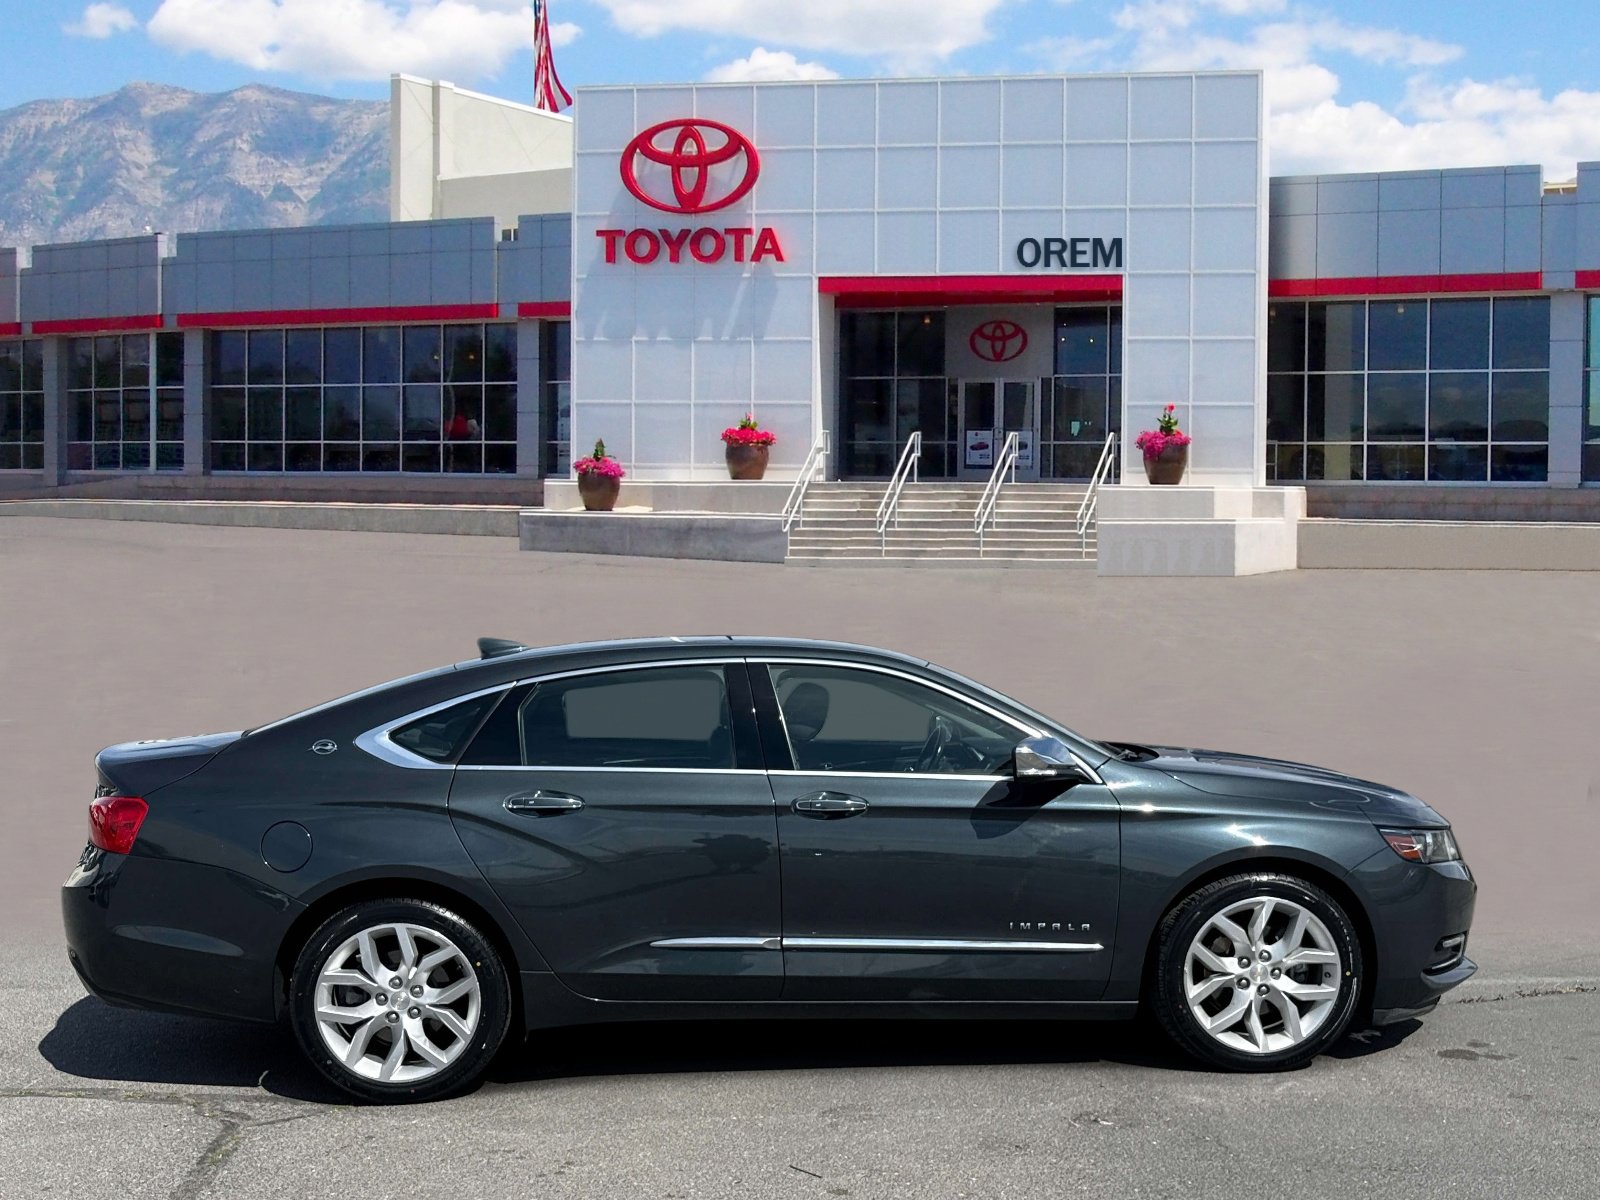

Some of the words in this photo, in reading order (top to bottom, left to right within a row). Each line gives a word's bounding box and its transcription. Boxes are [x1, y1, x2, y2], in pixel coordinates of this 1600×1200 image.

[596, 227, 784, 264] TOYOTA
[1017, 237, 1123, 267] OREM
[1009, 922, 1091, 931] IMPALA
